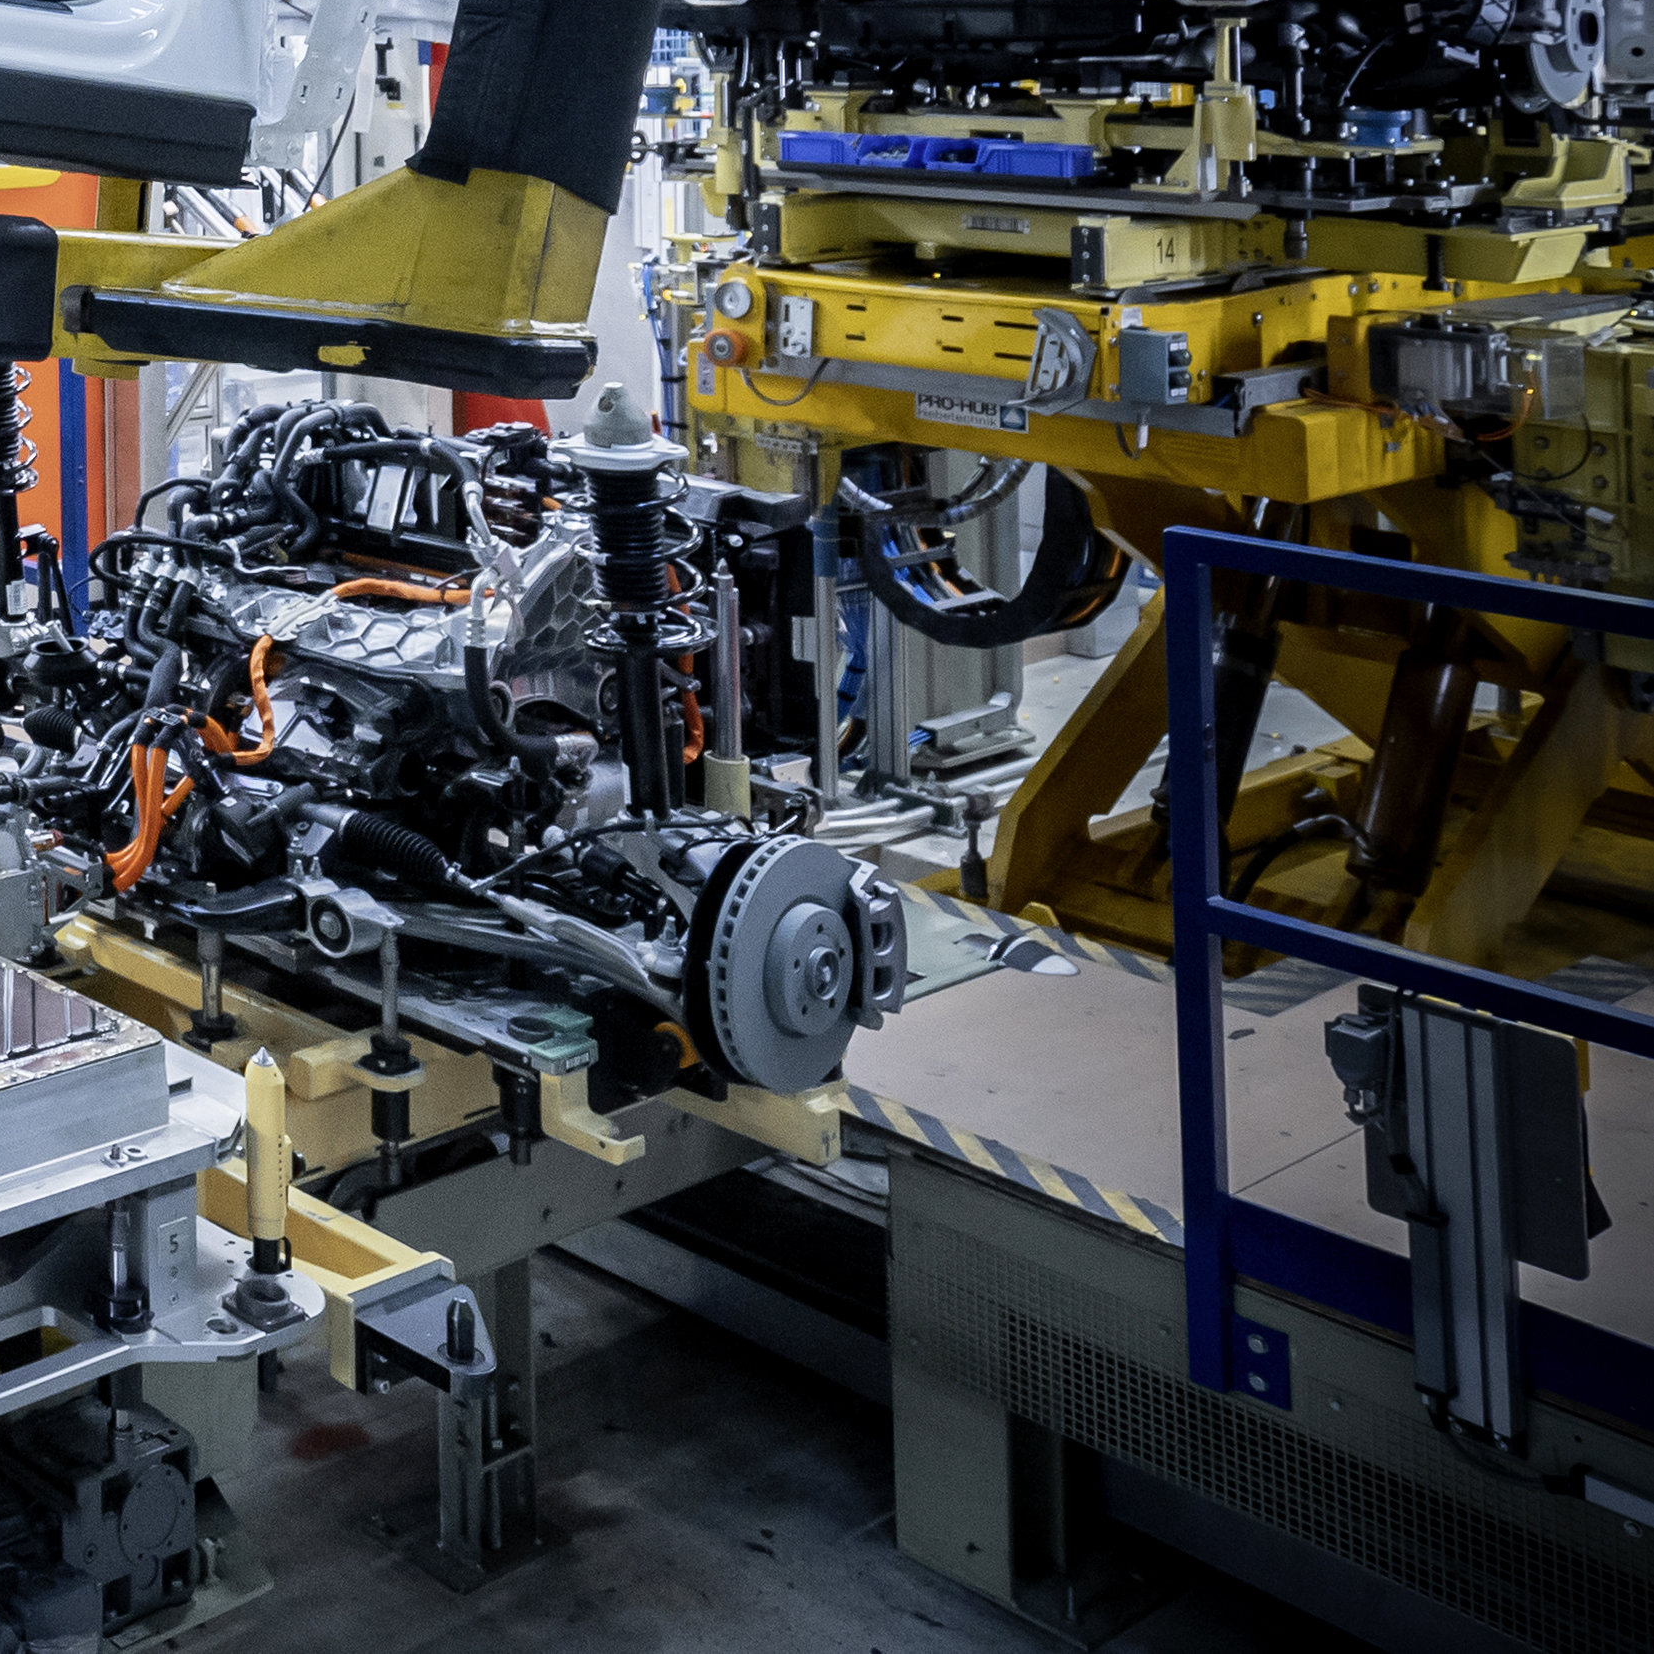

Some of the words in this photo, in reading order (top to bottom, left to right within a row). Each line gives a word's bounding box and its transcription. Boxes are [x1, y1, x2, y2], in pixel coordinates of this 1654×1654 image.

[1156, 236, 1176, 264] 14
[917, 392, 998, 417] PRO-HUB
[169, 1233, 179, 1254] 5
